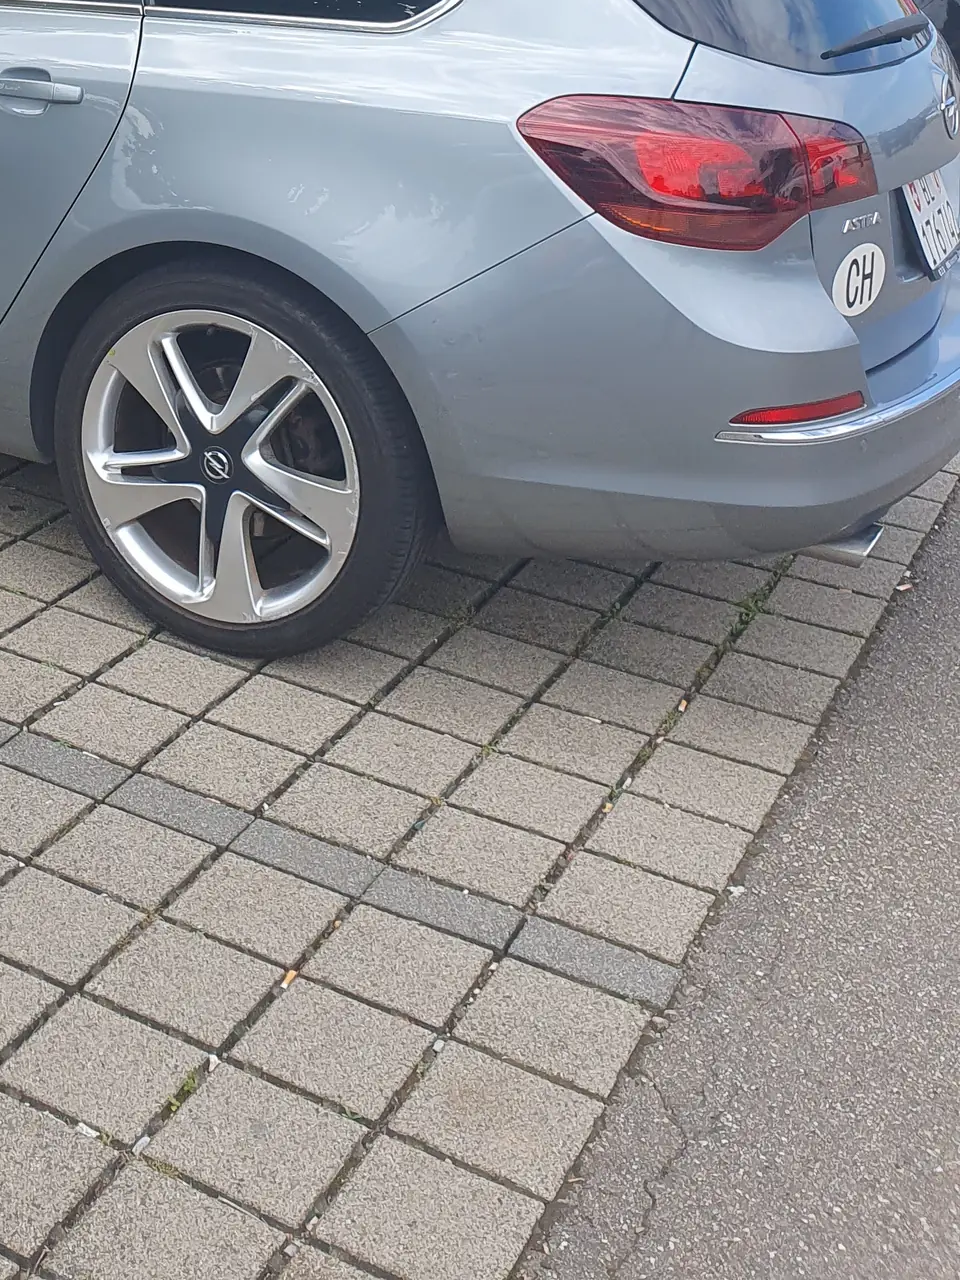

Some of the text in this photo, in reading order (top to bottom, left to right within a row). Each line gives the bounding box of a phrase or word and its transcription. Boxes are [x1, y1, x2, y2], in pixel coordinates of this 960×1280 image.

[919, 176, 936, 206] BL
[842, 211, 882, 234] ASTRA
[845, 251, 875, 309] CH
